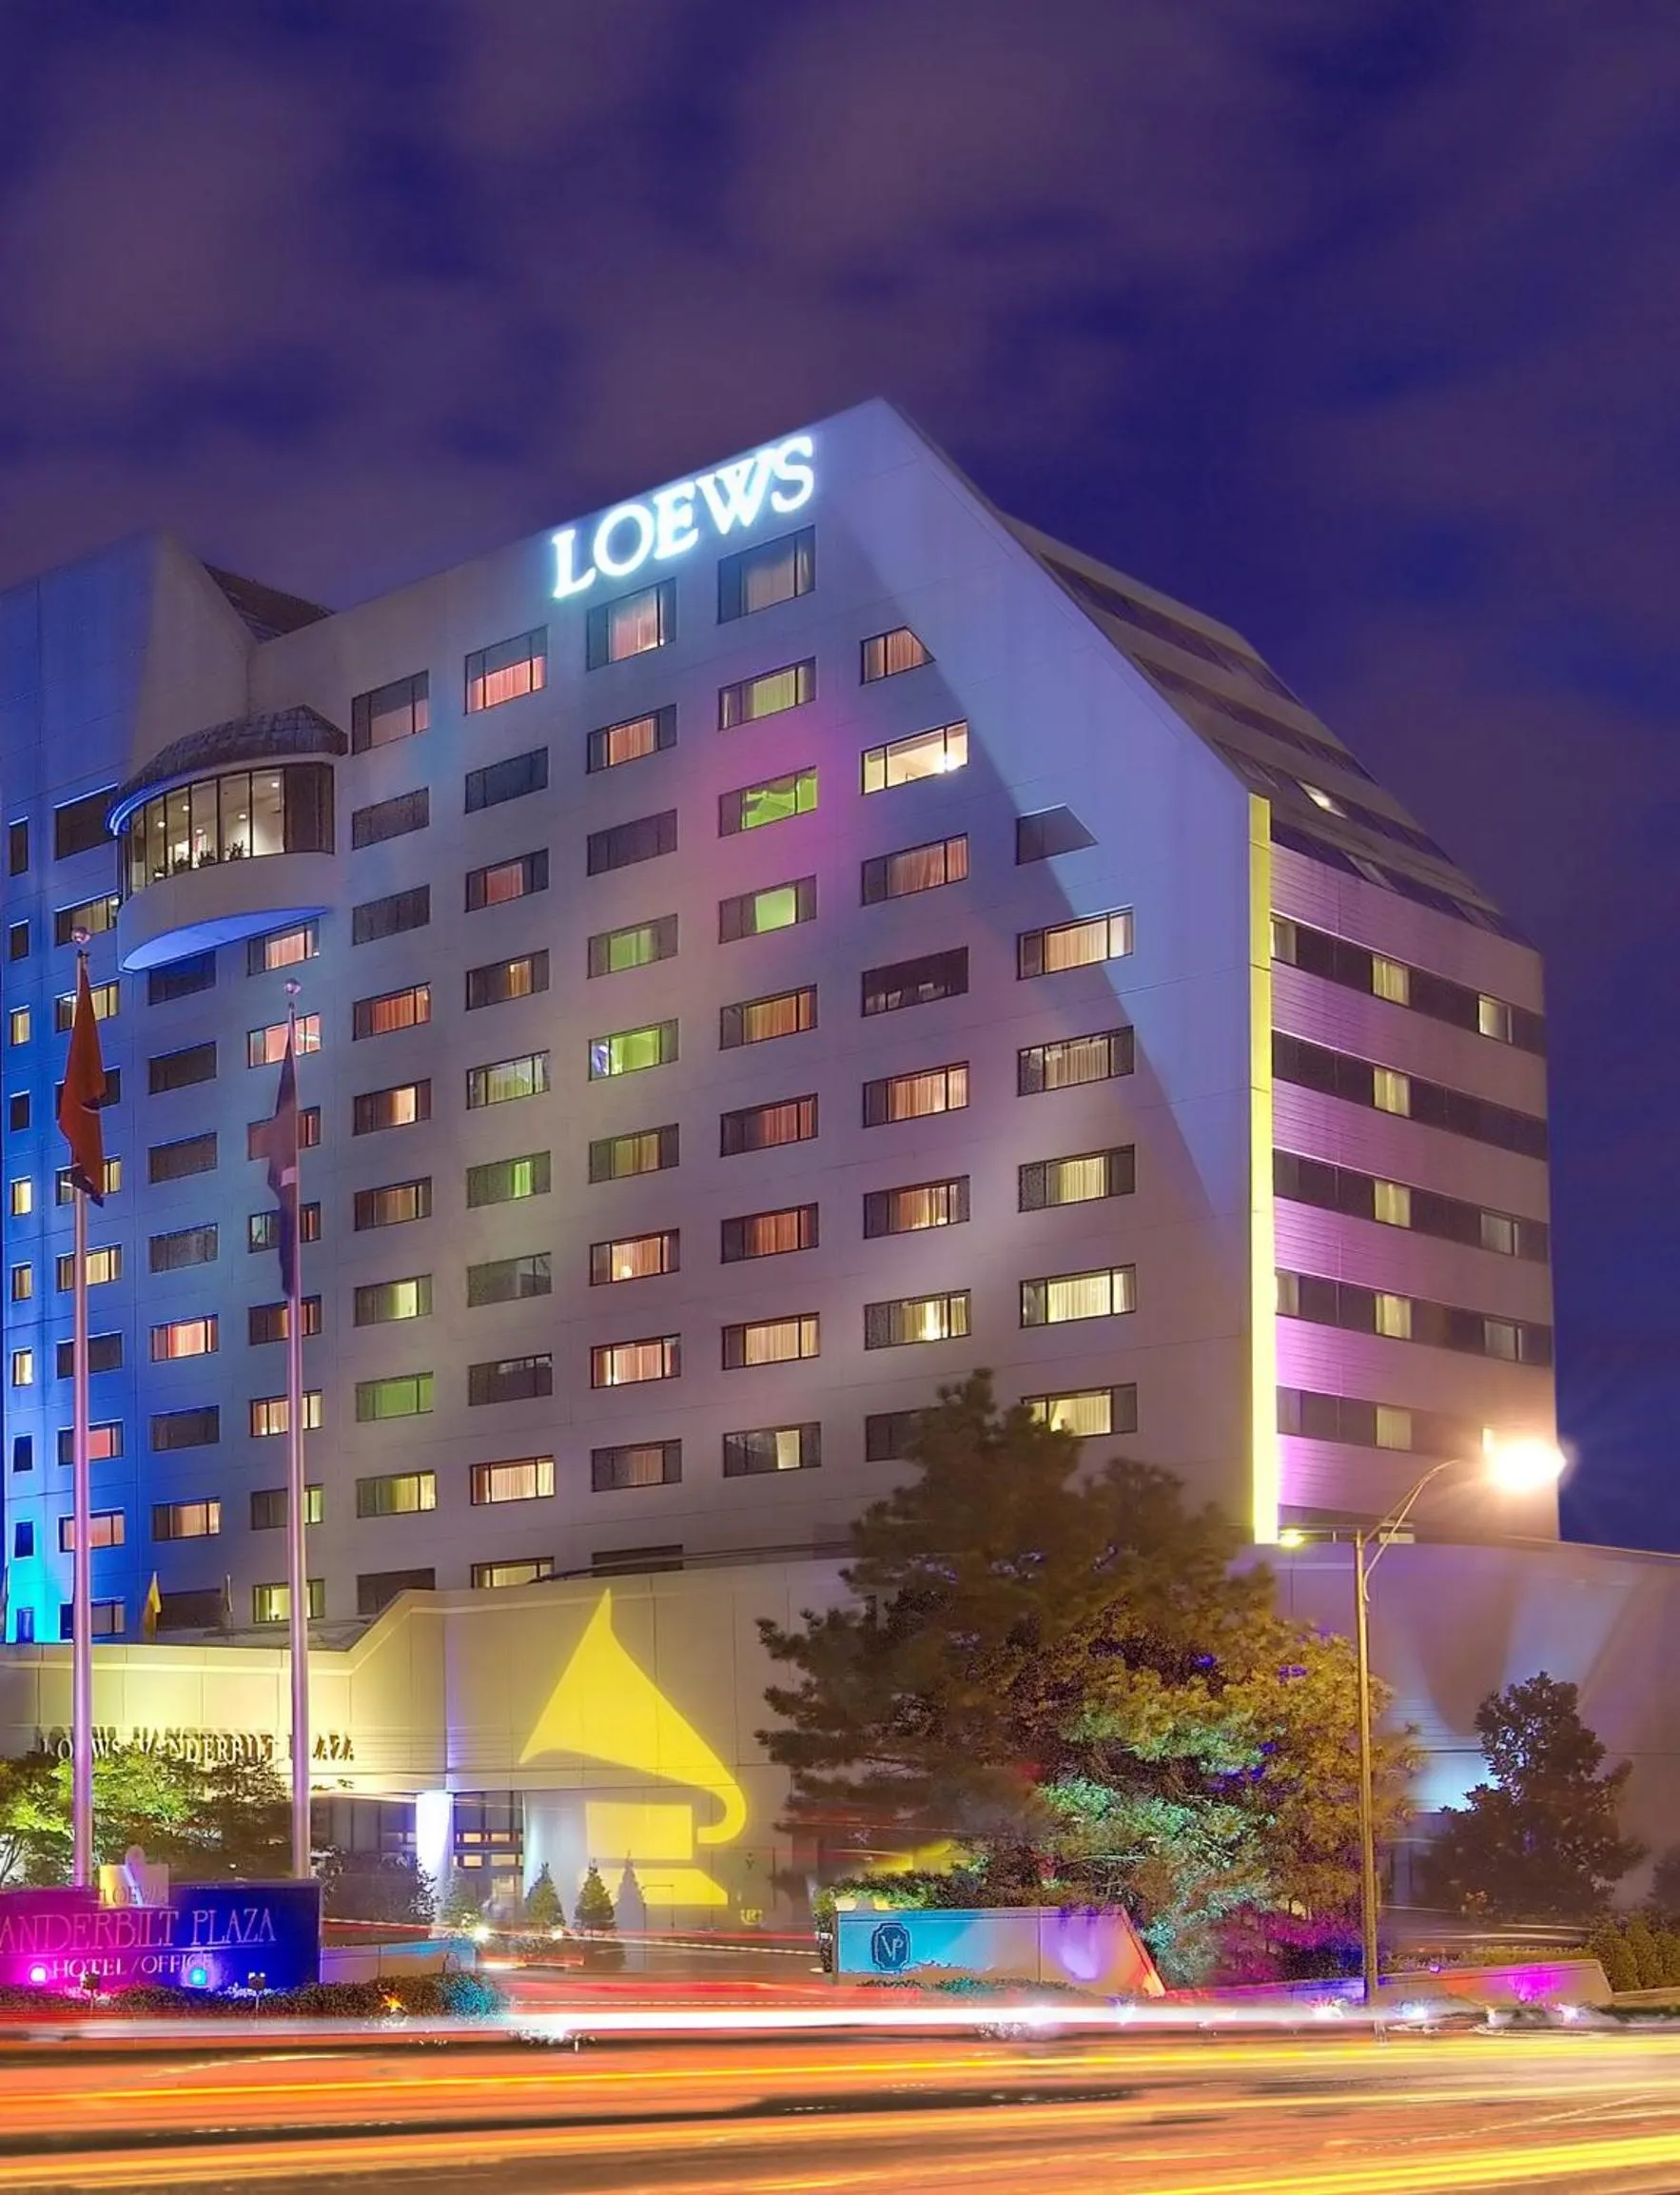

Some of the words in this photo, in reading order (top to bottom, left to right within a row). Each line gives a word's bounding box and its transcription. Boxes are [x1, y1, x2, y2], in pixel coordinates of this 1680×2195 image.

[551, 435, 815, 598] LOEWS
[0, 1910, 179, 1953] ANDERBILT
[190, 1908, 277, 1946] PLAZA
